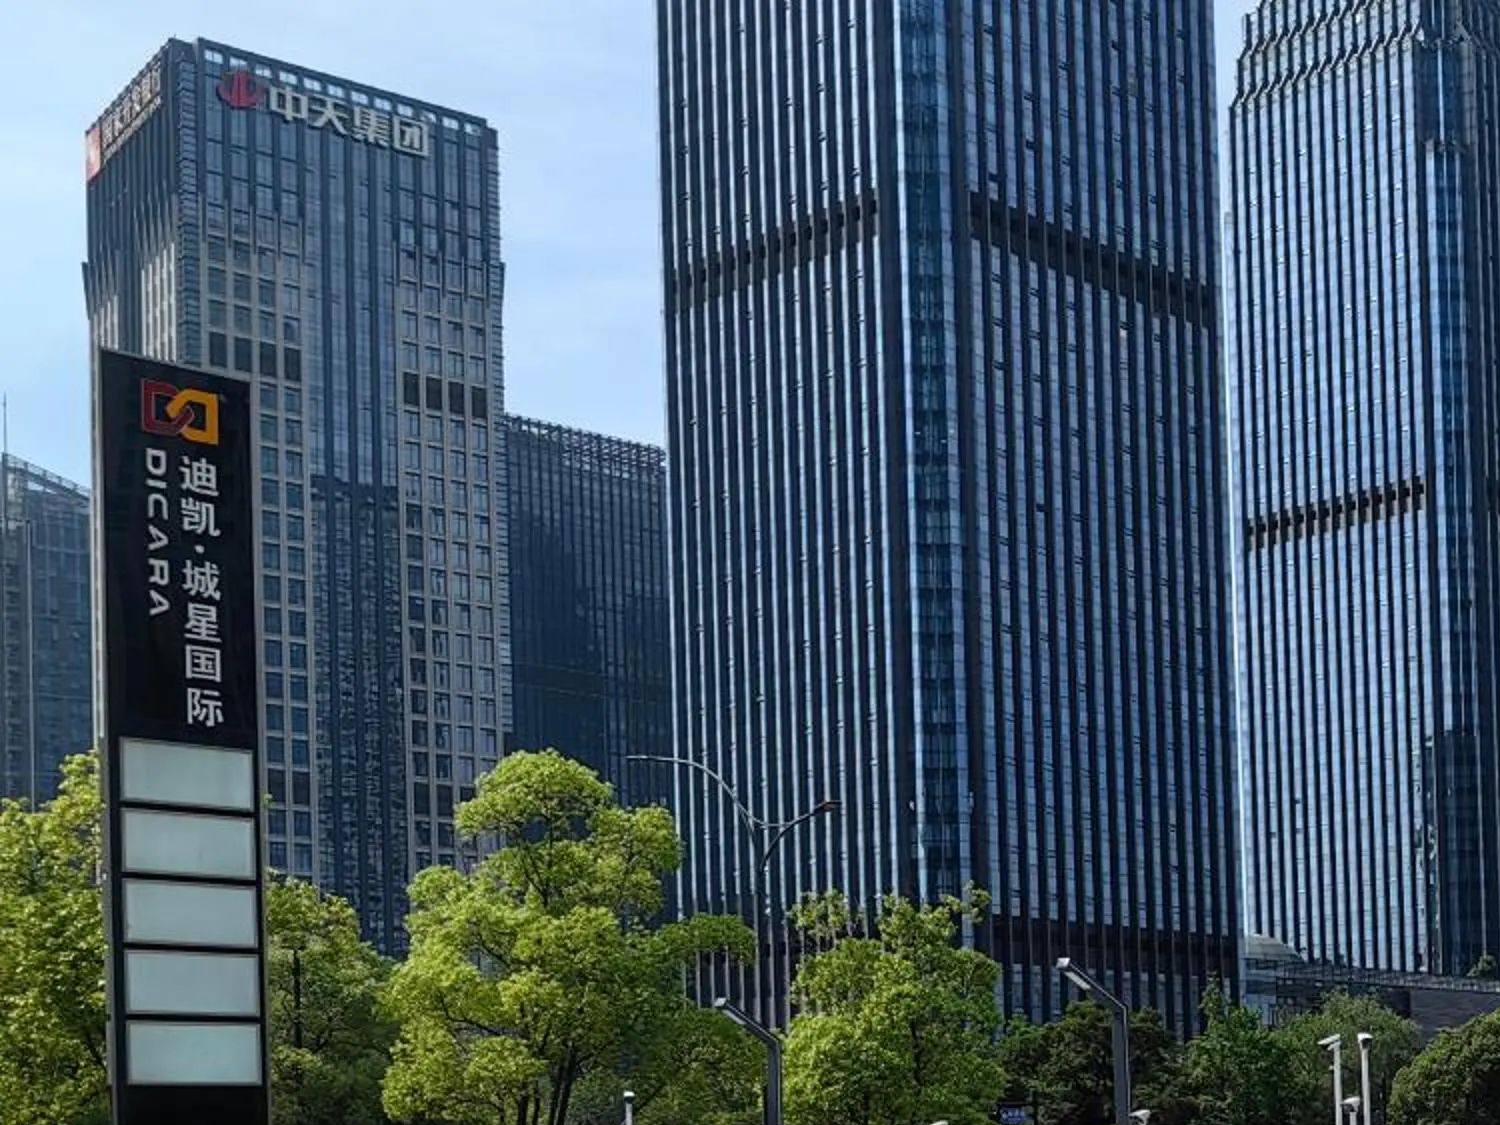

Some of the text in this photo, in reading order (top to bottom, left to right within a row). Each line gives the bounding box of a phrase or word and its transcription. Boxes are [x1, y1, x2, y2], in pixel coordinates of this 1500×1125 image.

[269, 85, 429, 158] 中天集团
[145, 448, 171, 616] DICARA
[179, 455, 224, 728] 迪凯·城星国际
